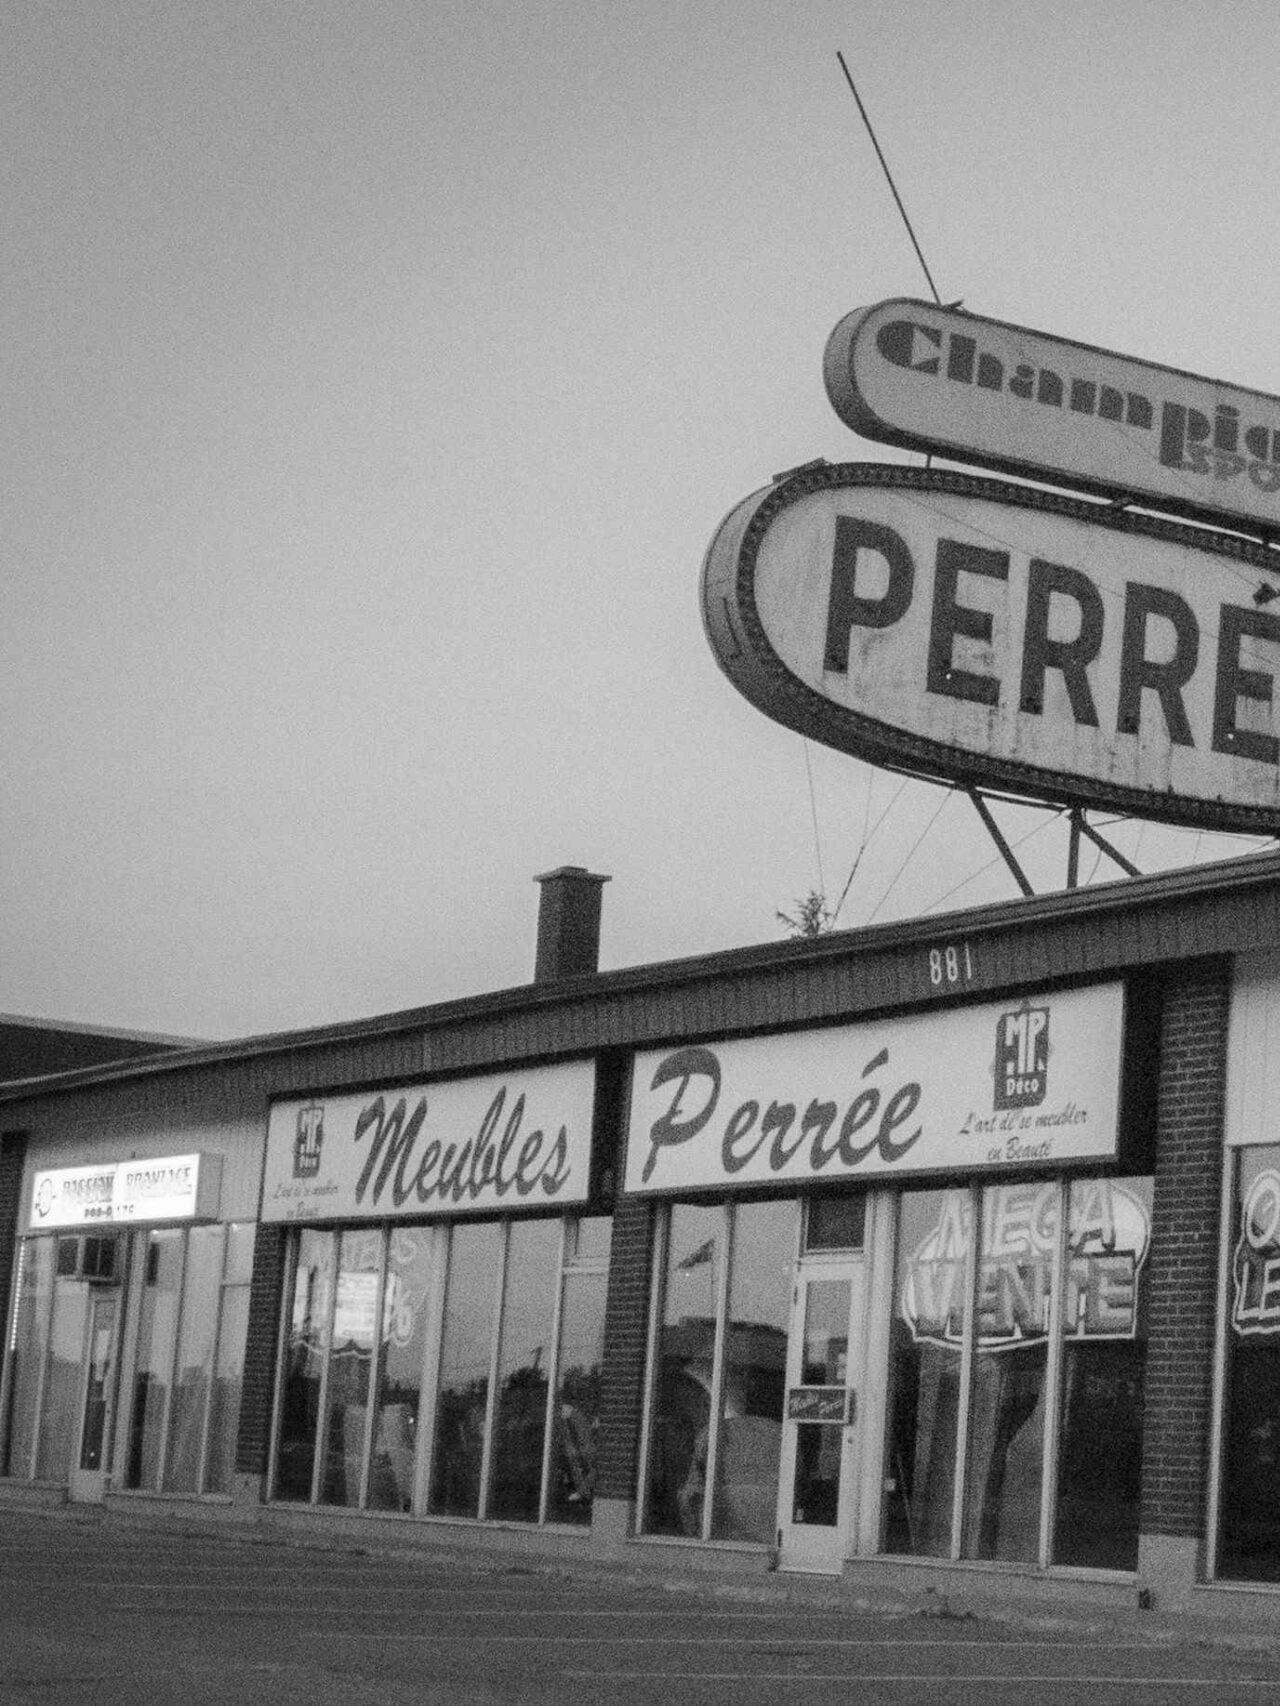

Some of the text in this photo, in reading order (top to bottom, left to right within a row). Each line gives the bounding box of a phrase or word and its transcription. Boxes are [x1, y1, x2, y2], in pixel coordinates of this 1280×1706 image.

[929, 940, 973, 985] 881
[353, 1085, 572, 1209] Meubles
[641, 1046, 923, 1185] Perrée
[1035, 1100, 1087, 1128] meubler
